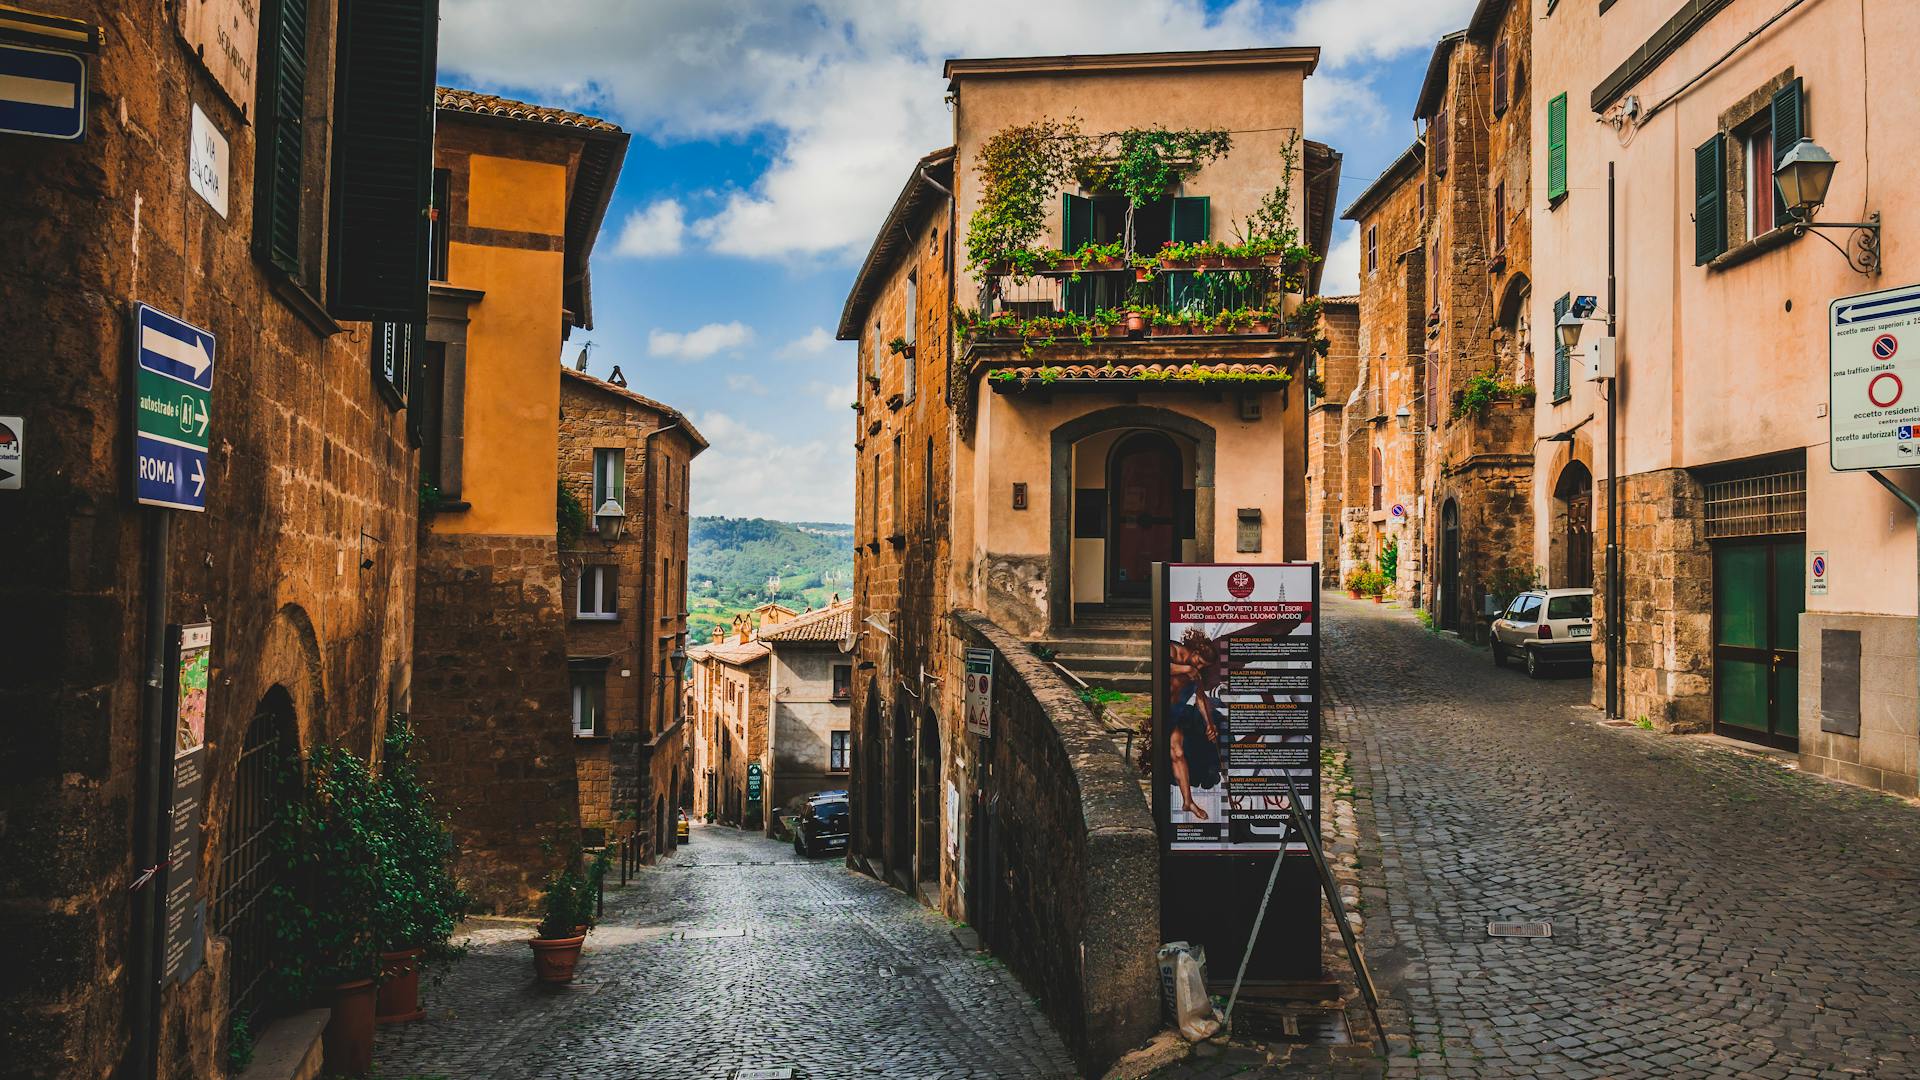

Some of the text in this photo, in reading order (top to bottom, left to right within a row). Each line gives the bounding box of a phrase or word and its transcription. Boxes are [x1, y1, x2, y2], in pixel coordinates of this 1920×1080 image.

[205, 131, 216, 162] VIA
[203, 164, 220, 197] CAVA
[1837, 328, 1858, 336] eccetto
[1860, 325, 1876, 333] mezzi
[1878, 319, 1904, 330] superiori
[1847, 366, 1870, 375] traffico
[140, 395, 175, 417] autostrade
[182, 402, 193, 425] A1
[1853, 405, 1920, 419] eccetto residenti
[1835, 433, 1860, 442] eccetto
[1861, 429, 1897, 440] autorizzati
[140, 455, 176, 485] ROMA
[1186, 604, 1214, 612] DUOMO
[1222, 604, 1253, 612] ORVIETO
[1279, 604, 1303, 612] TESORI
